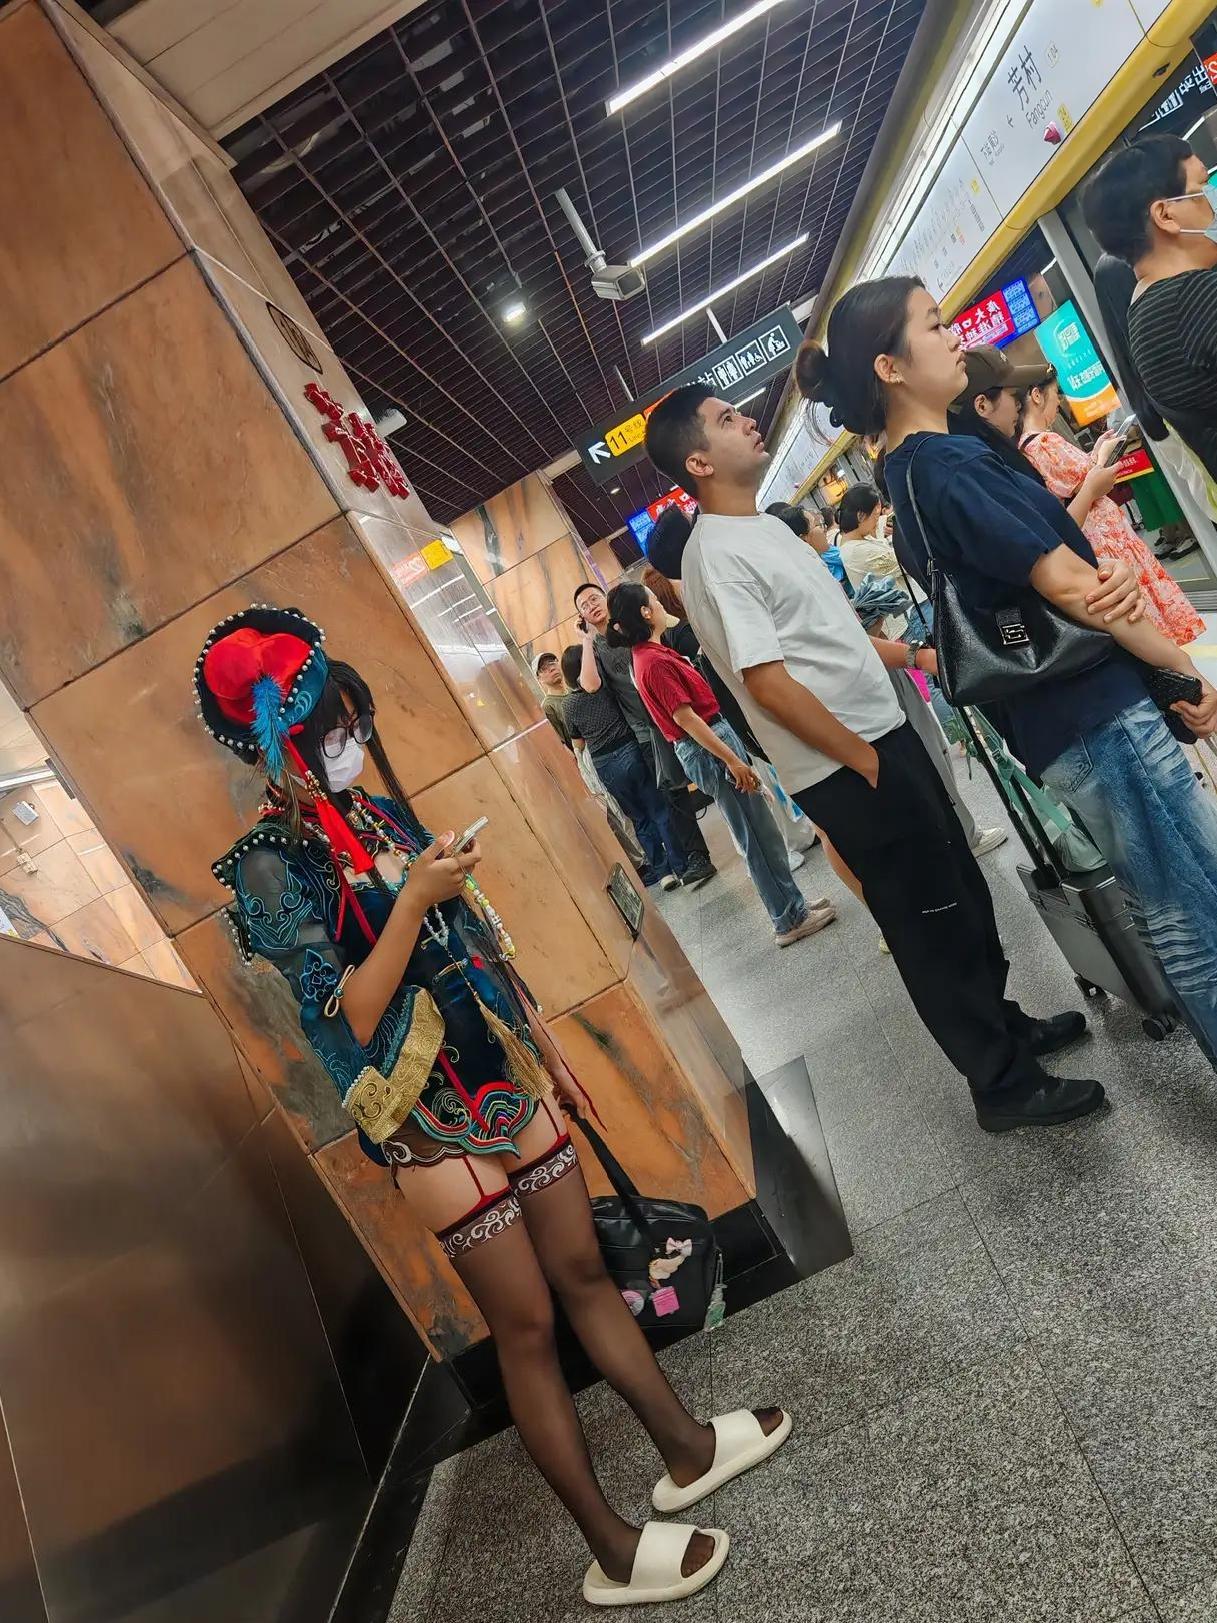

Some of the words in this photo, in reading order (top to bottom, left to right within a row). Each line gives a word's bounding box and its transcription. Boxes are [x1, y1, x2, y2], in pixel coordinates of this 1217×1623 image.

[1007, 45, 1042, 111] 芳村
[1025, 90, 1054, 129] Fangcun
[608, 430, 630, 451] 11
